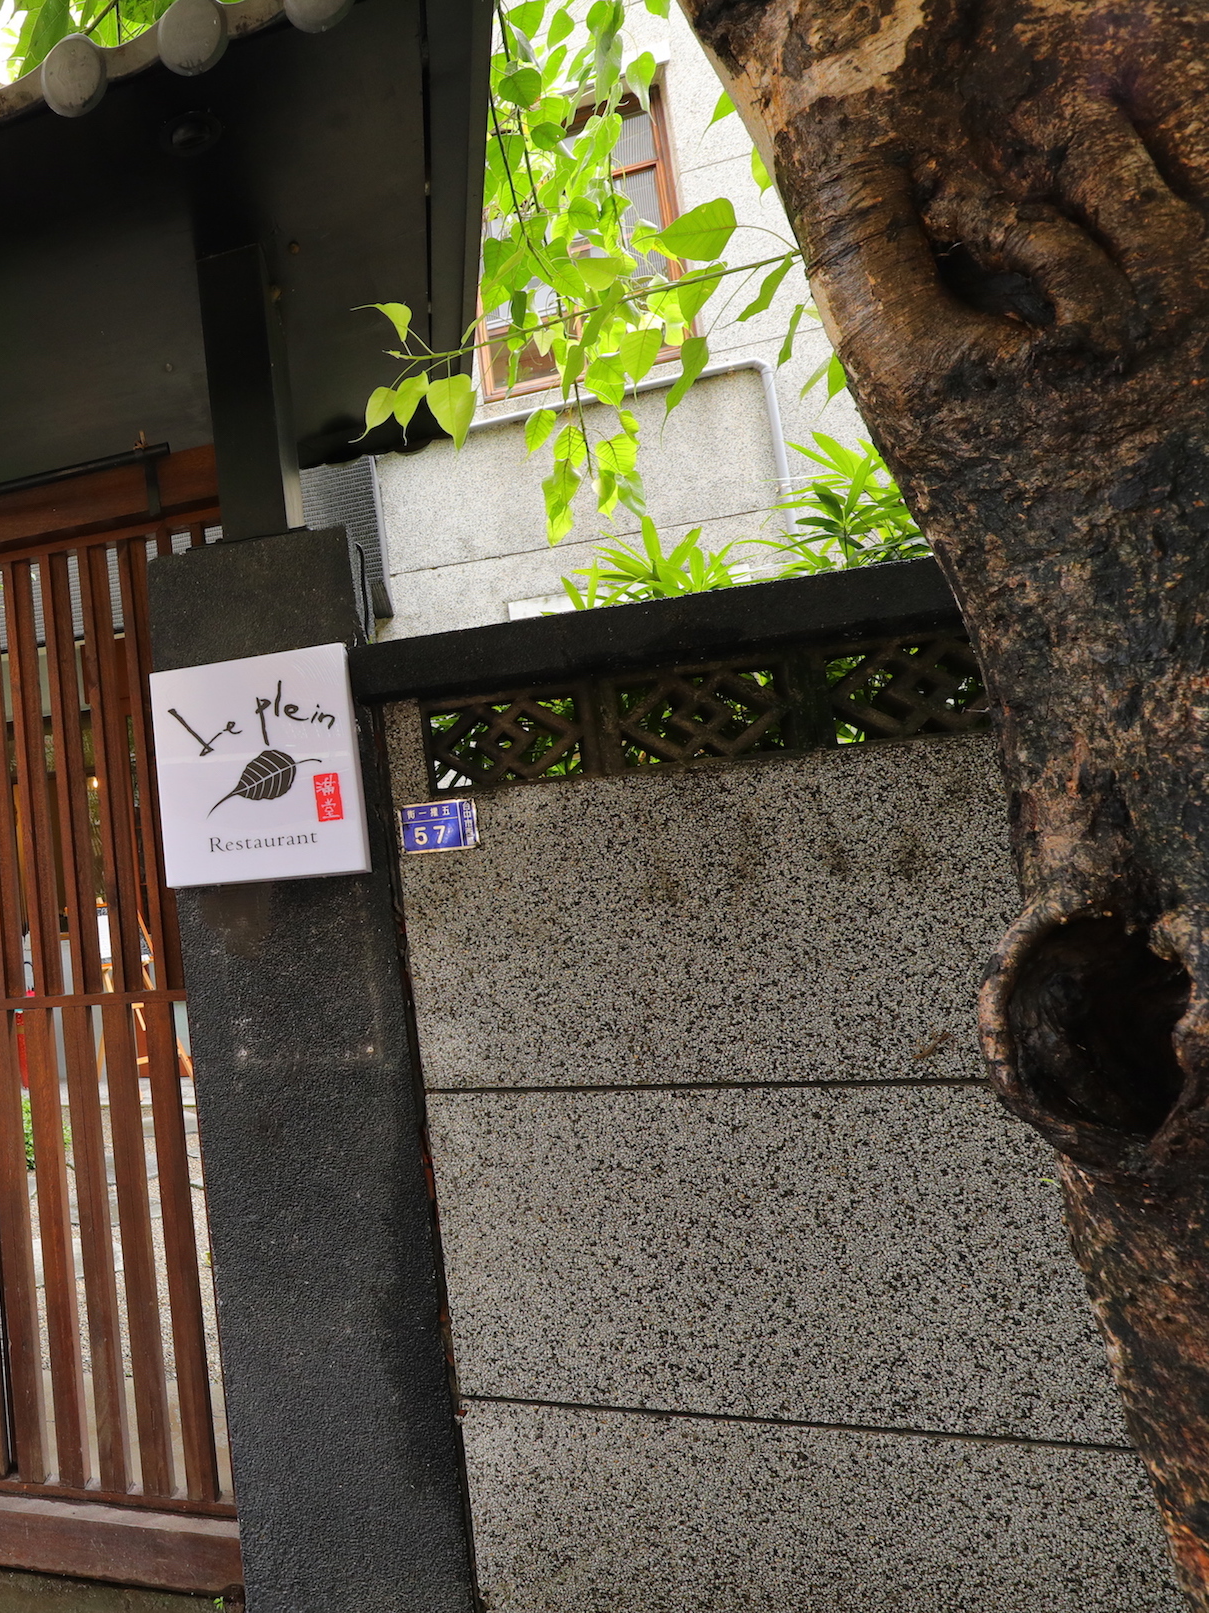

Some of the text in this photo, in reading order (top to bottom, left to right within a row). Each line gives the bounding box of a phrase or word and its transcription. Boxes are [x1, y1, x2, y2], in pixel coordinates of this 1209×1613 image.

[168, 708, 243, 756] Le
[209, 831, 318, 853] Restaurant
[414, 825, 446, 845] 57
